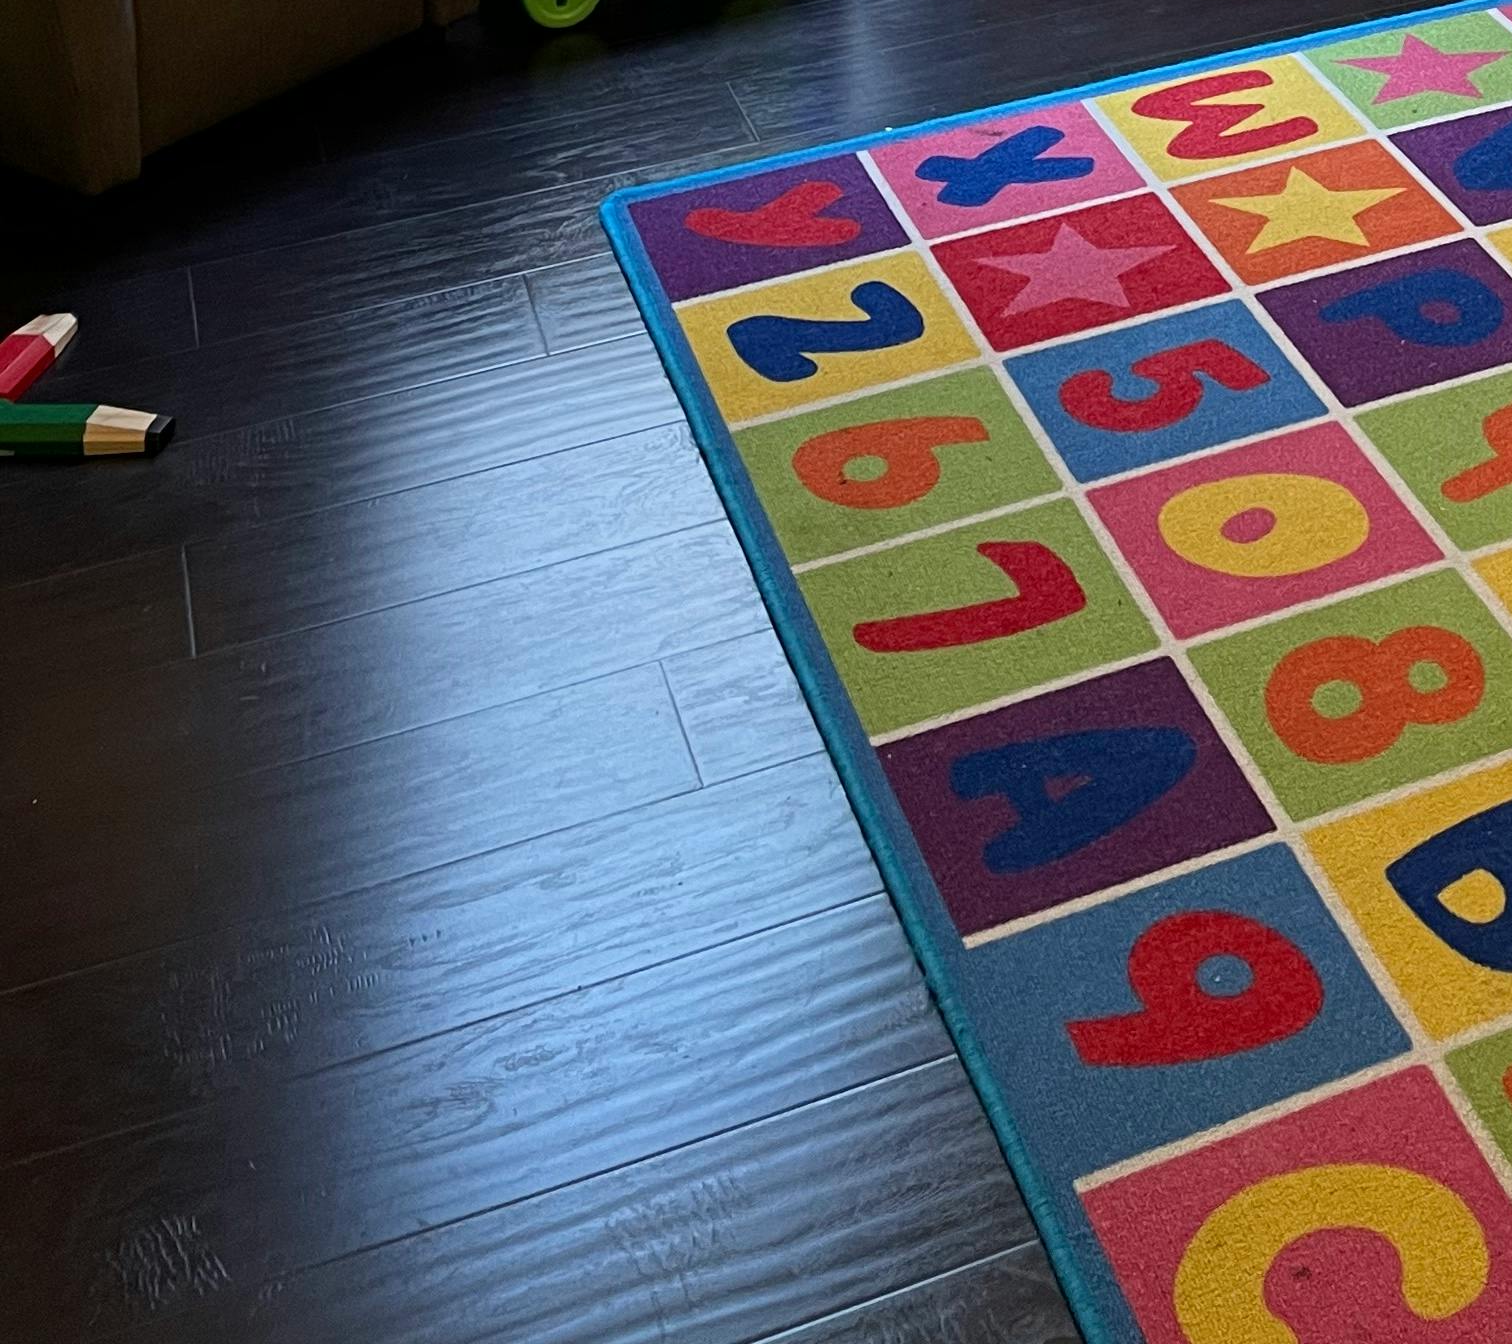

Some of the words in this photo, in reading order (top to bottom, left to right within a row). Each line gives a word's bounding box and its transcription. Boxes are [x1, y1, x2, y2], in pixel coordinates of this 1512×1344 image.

[685, 181, 861, 248] Y
[915, 126, 1094, 206] X
[1317, 268, 1505, 348] P
[1059, 339, 1271, 432] 5
[792, 416, 990, 509] 6
[852, 541, 1086, 653] 7
[1264, 625, 1484, 764] 8
[950, 726, 1198, 874] A
[1065, 908, 1325, 1068] 9
[1173, 1163, 1489, 1344] C
